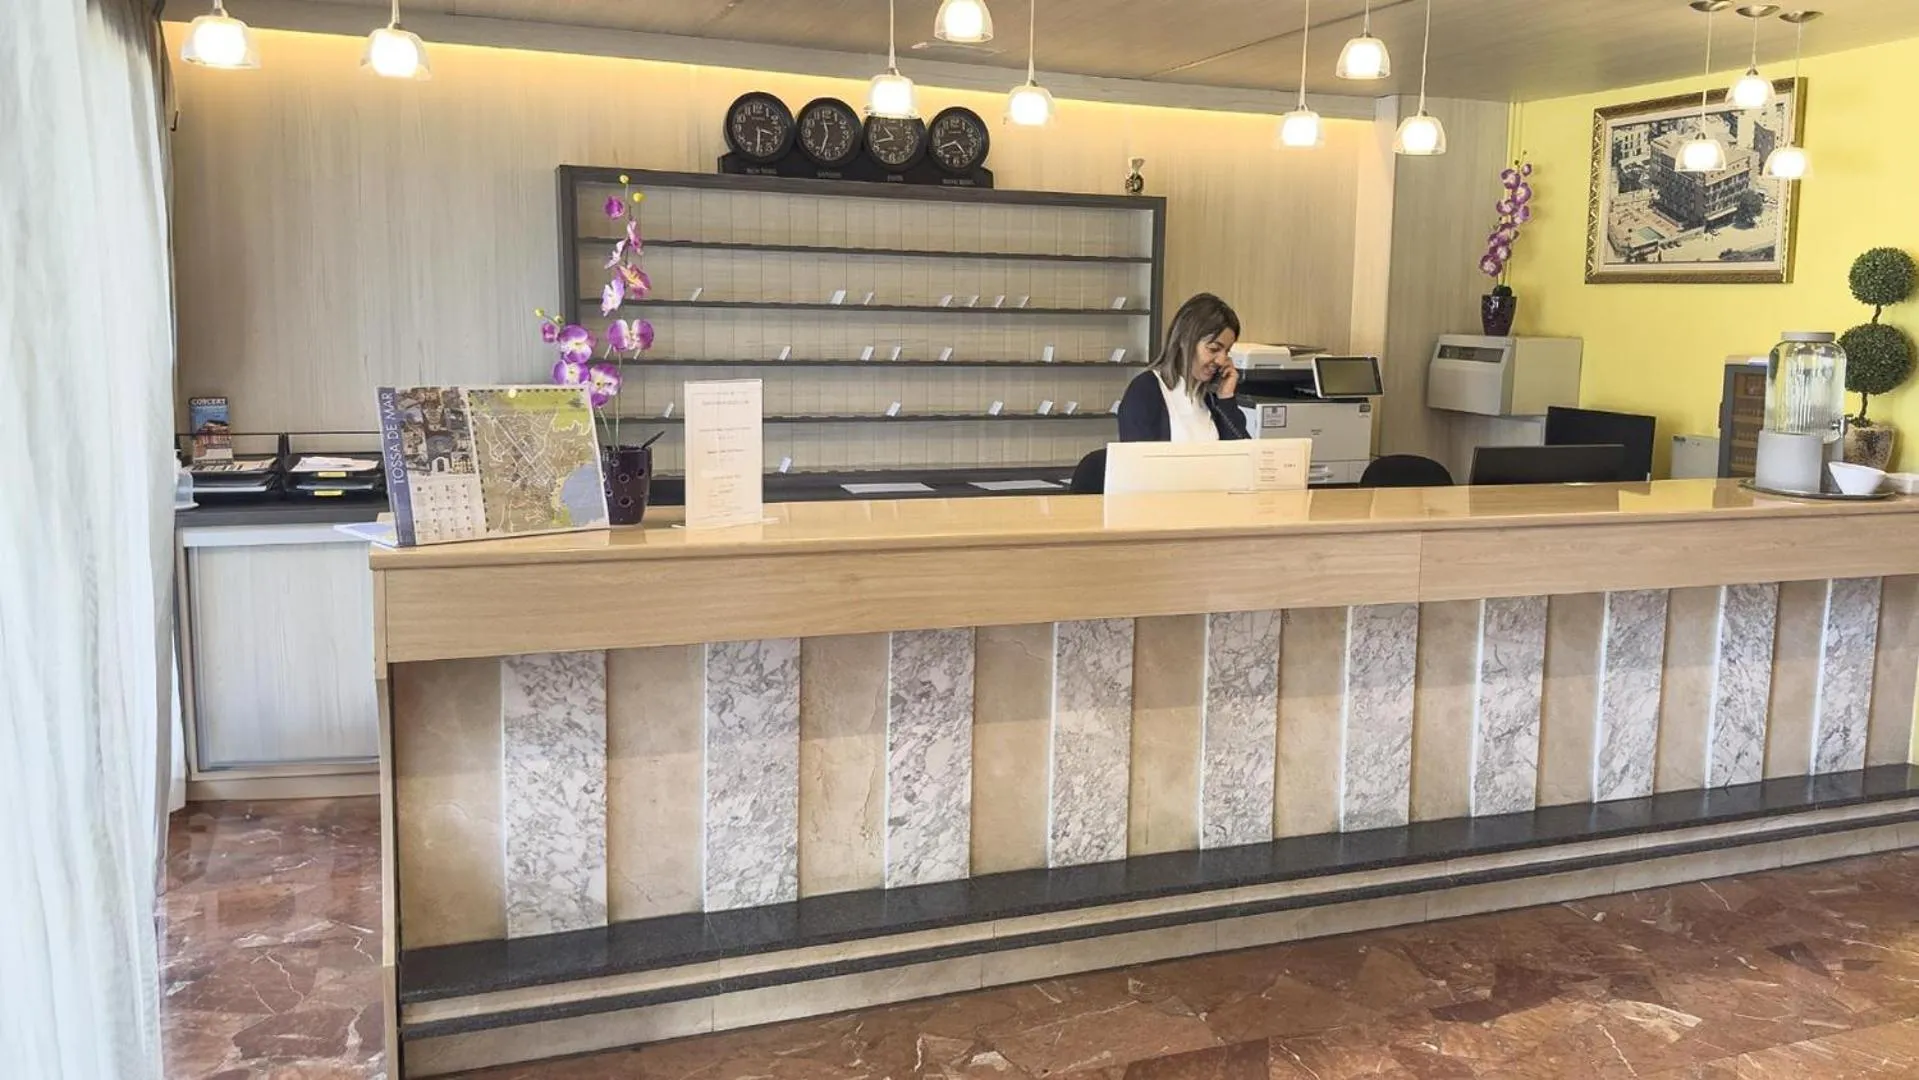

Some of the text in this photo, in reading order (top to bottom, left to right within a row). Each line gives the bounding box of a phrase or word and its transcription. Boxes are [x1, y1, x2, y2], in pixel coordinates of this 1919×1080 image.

[381, 392, 405, 484] TOSSA DE MAR
